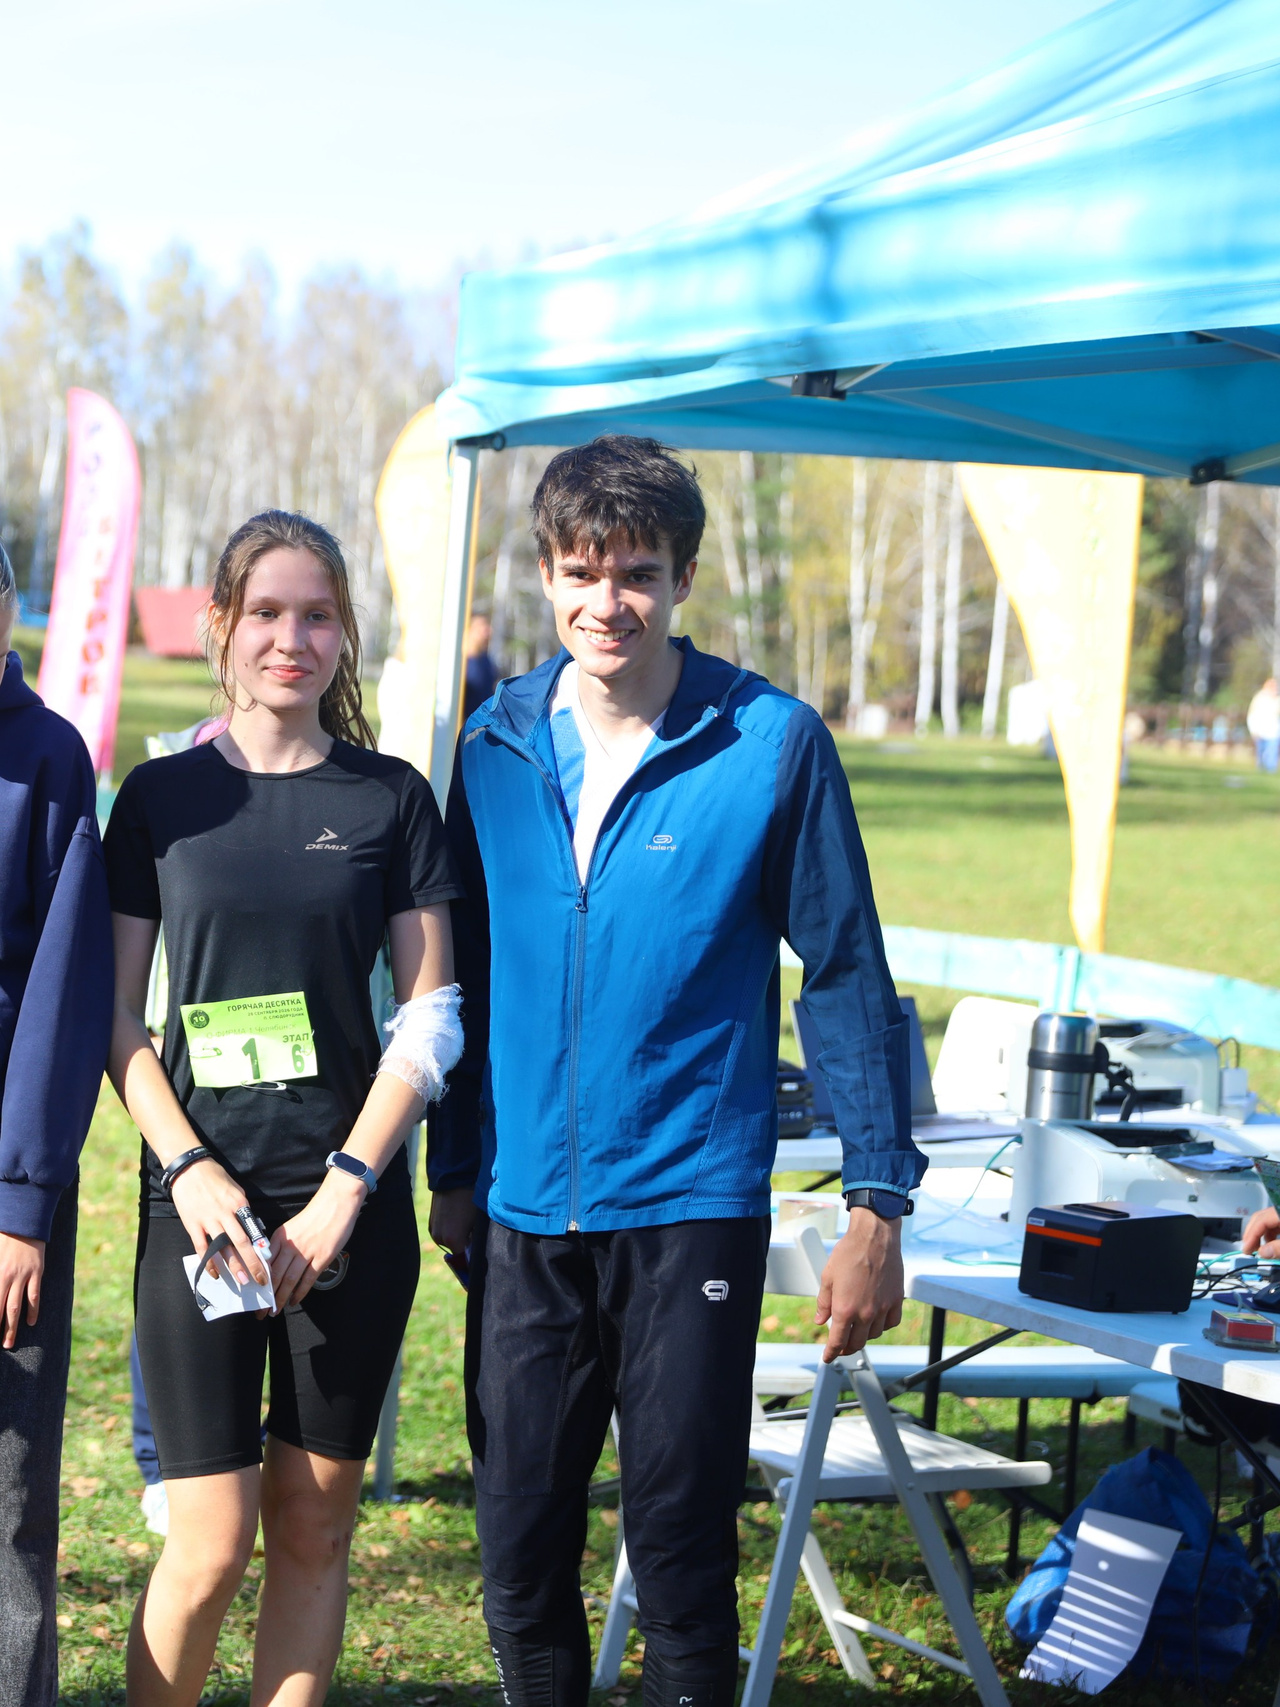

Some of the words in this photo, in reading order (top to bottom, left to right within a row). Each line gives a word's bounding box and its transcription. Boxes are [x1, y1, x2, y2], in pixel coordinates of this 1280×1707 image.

[305, 843, 350, 851] DEMIX
[645, 844, 677, 852] Kalenji
[227, 1002, 264, 1012] ГОРЯЧАЯ
[265, 998, 302, 1009] ДЕСЯТКА
[192, 1015, 205, 1023] 10
[282, 1033, 310, 1043] ЭТАП
[241, 1037, 261, 1080] 1
[291, 1043, 306, 1074] 6
